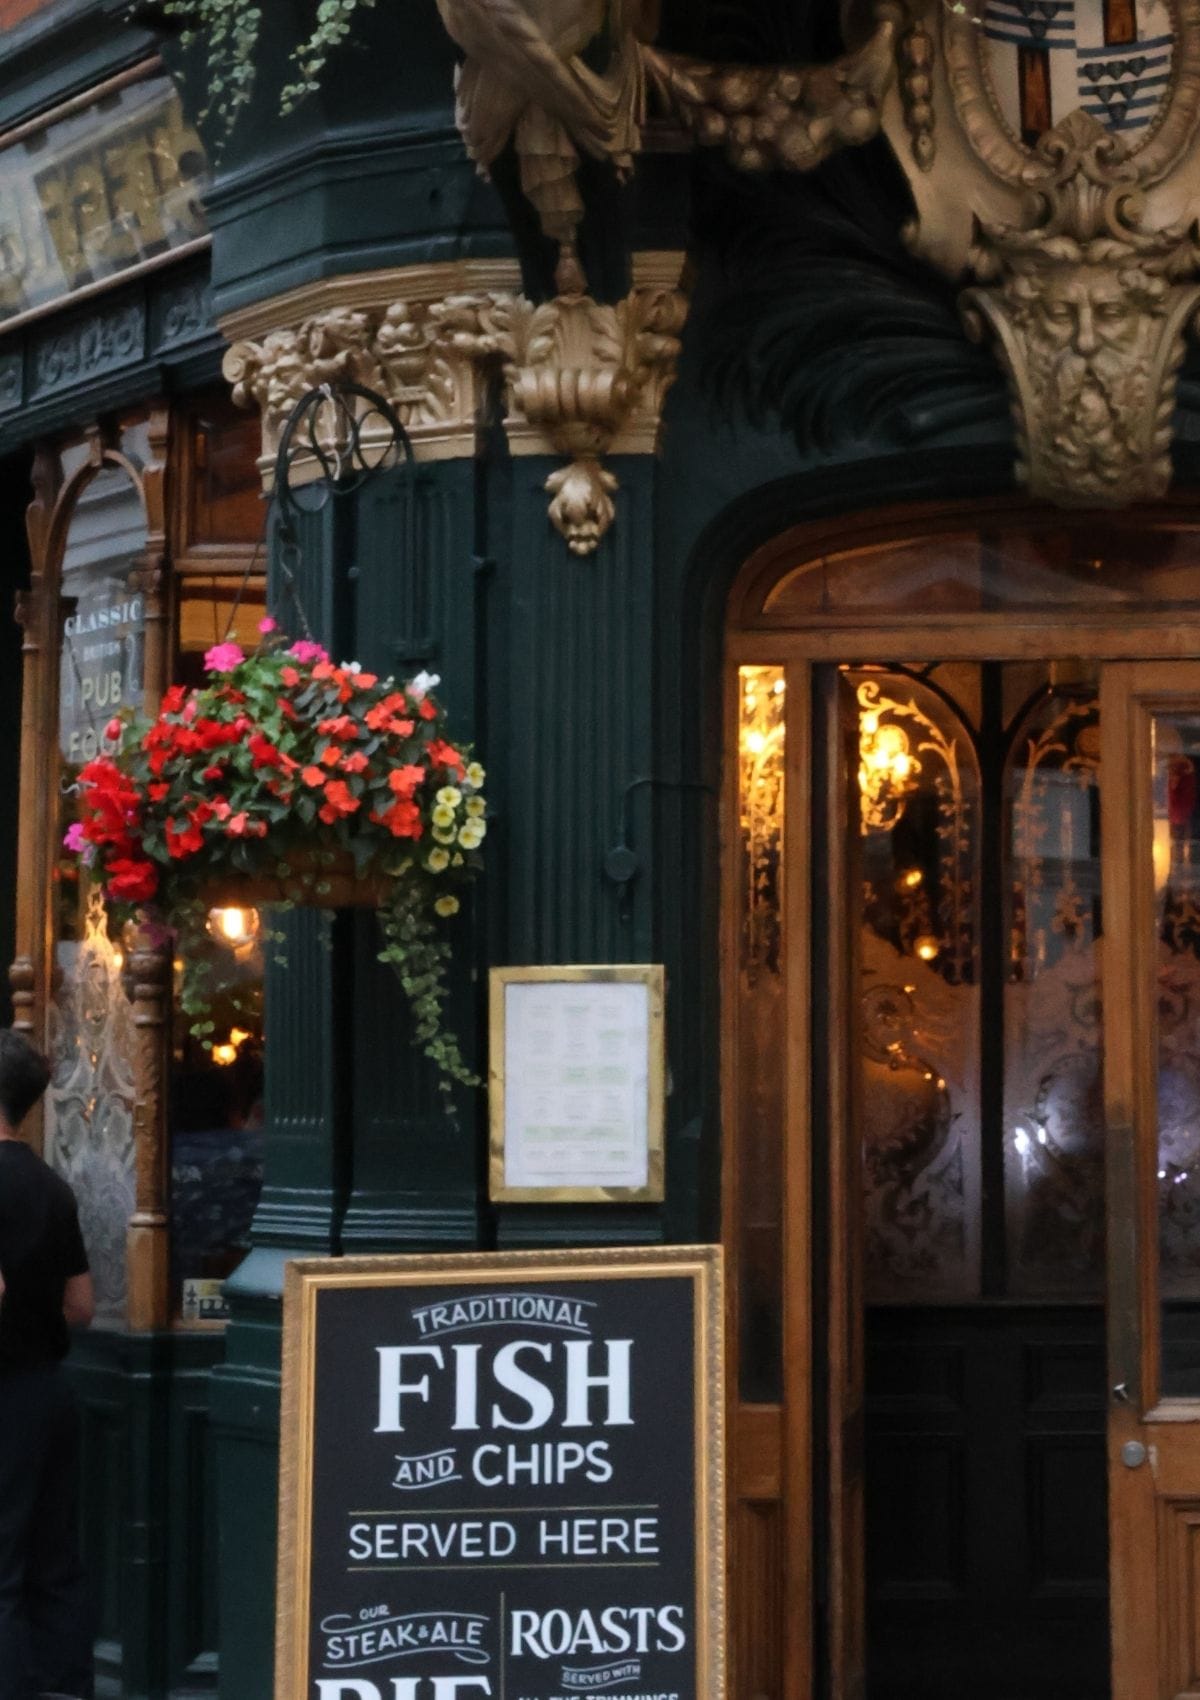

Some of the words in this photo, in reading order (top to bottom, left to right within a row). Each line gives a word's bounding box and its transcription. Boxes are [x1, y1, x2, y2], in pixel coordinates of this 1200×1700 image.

[64, 600, 141, 636] CLASSIC
[80, 670, 122, 709] PUB
[412, 1298, 588, 1333] TRADITIONAL
[373, 1339, 635, 1432] FISH
[395, 1455, 455, 1483] AND
[472, 1441, 614, 1487] CHIPS
[348, 1522, 517, 1560] SERVED
[539, 1519, 660, 1555] HERE
[359, 1604, 390, 1620] OUR
[510, 1605, 686, 1660] ROASTS
[562, 1671, 611, 1685] SERVED
[612, 1664, 641, 1678] WITH
